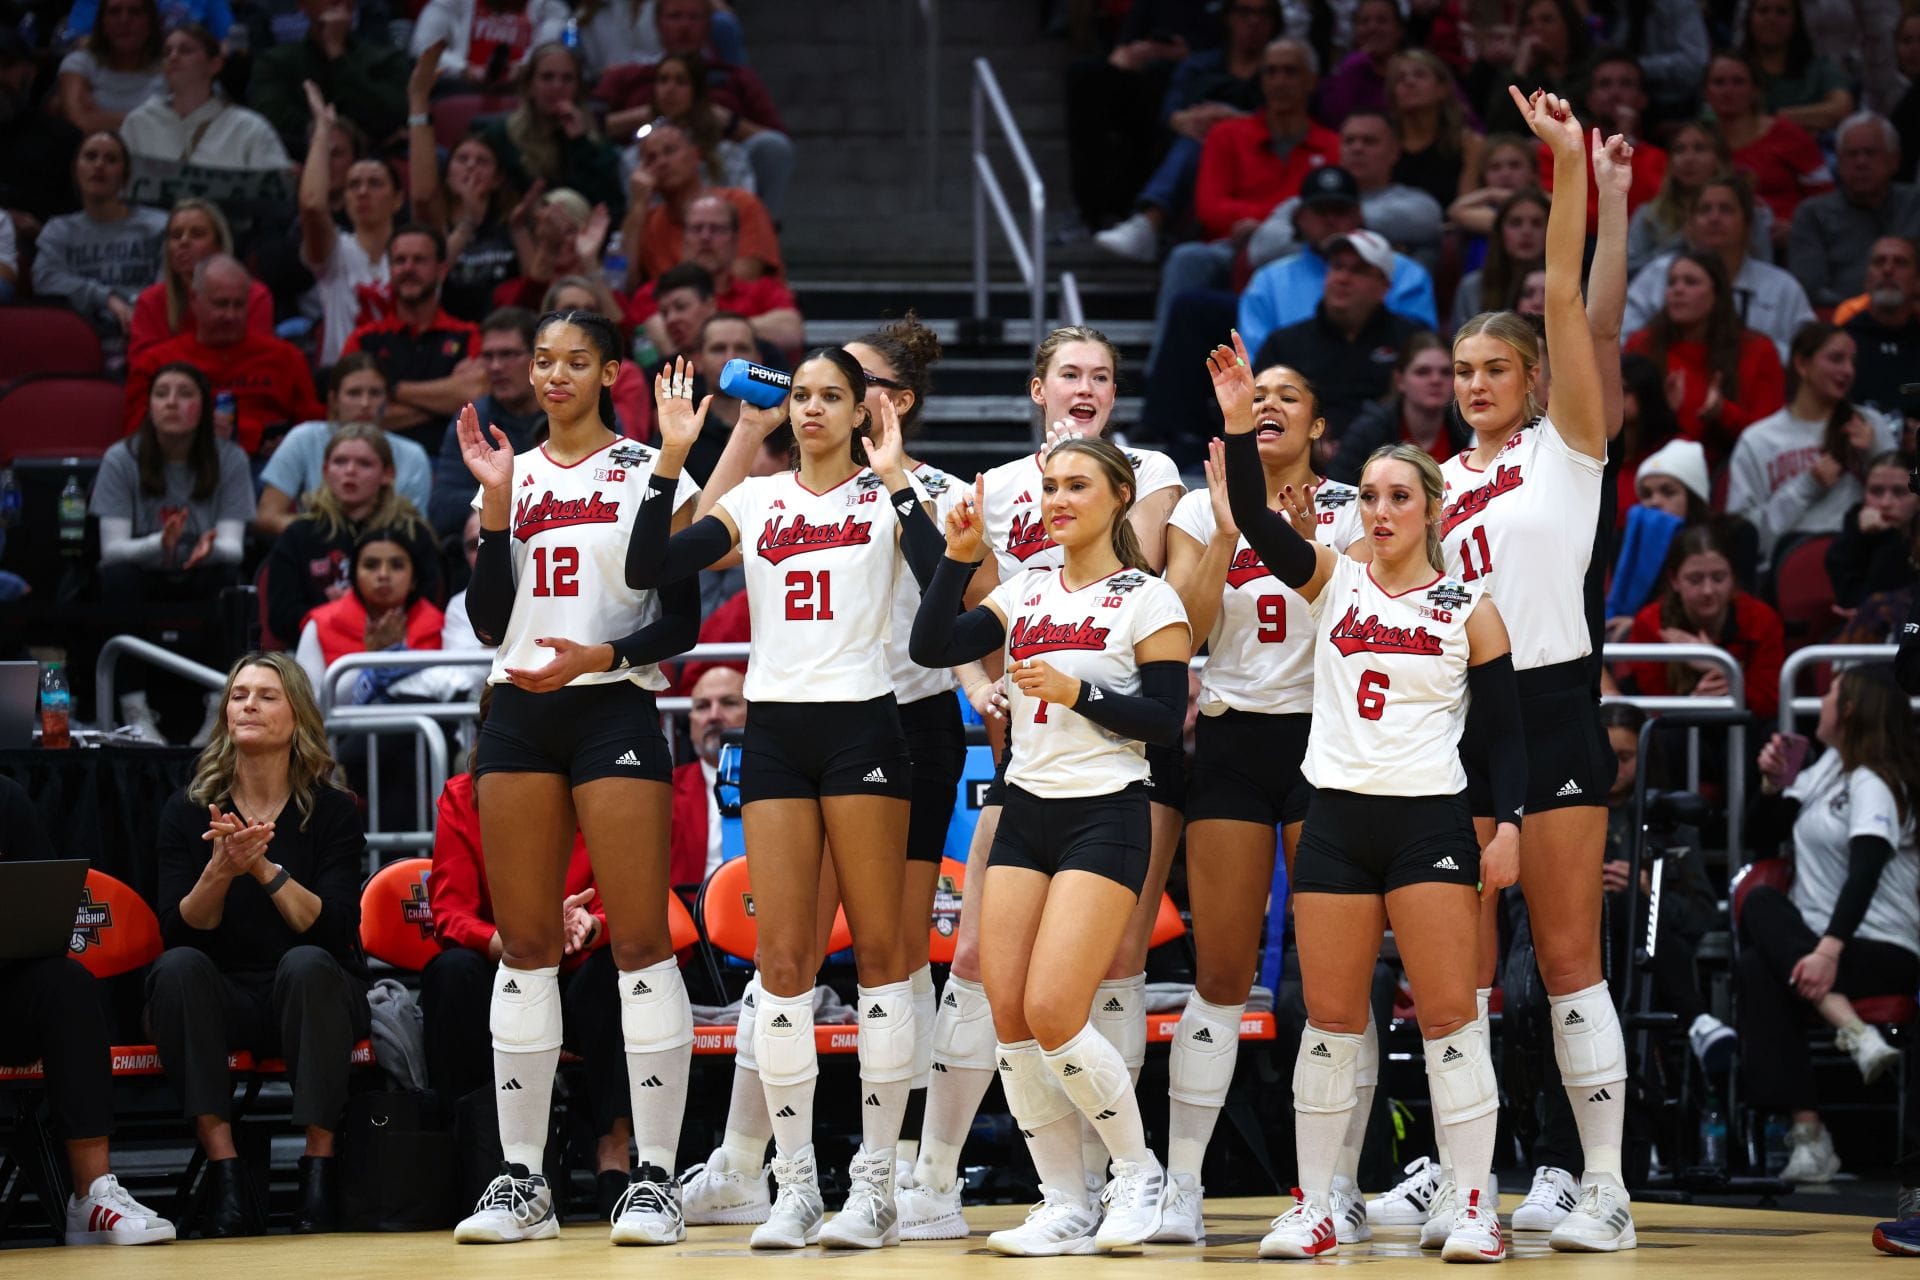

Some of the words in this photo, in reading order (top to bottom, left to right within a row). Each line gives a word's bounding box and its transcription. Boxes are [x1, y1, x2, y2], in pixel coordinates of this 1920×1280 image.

[751, 366, 791, 386] POWER
[513, 490, 620, 533] Nebraska
[757, 513, 873, 551] Nebraska
[532, 546, 580, 597] 12
[1459, 524, 1493, 583] 11
[785, 569, 834, 621] 21
[1010, 614, 1109, 650] Nebraska
[1256, 594, 1287, 643] 9
[1330, 602, 1444, 651] Nebraska
[1356, 668, 1390, 721] 6
[1556, 788, 1583, 797] adidas
[631, 988, 652, 996] adidas
[1192, 1035, 1214, 1044] adidas
[1564, 1018, 1585, 1026] adidas
[112, 1055, 162, 1070] CHAMPI
[1311, 1050, 1331, 1058] adidas
[1442, 1052, 1463, 1063] adidas
